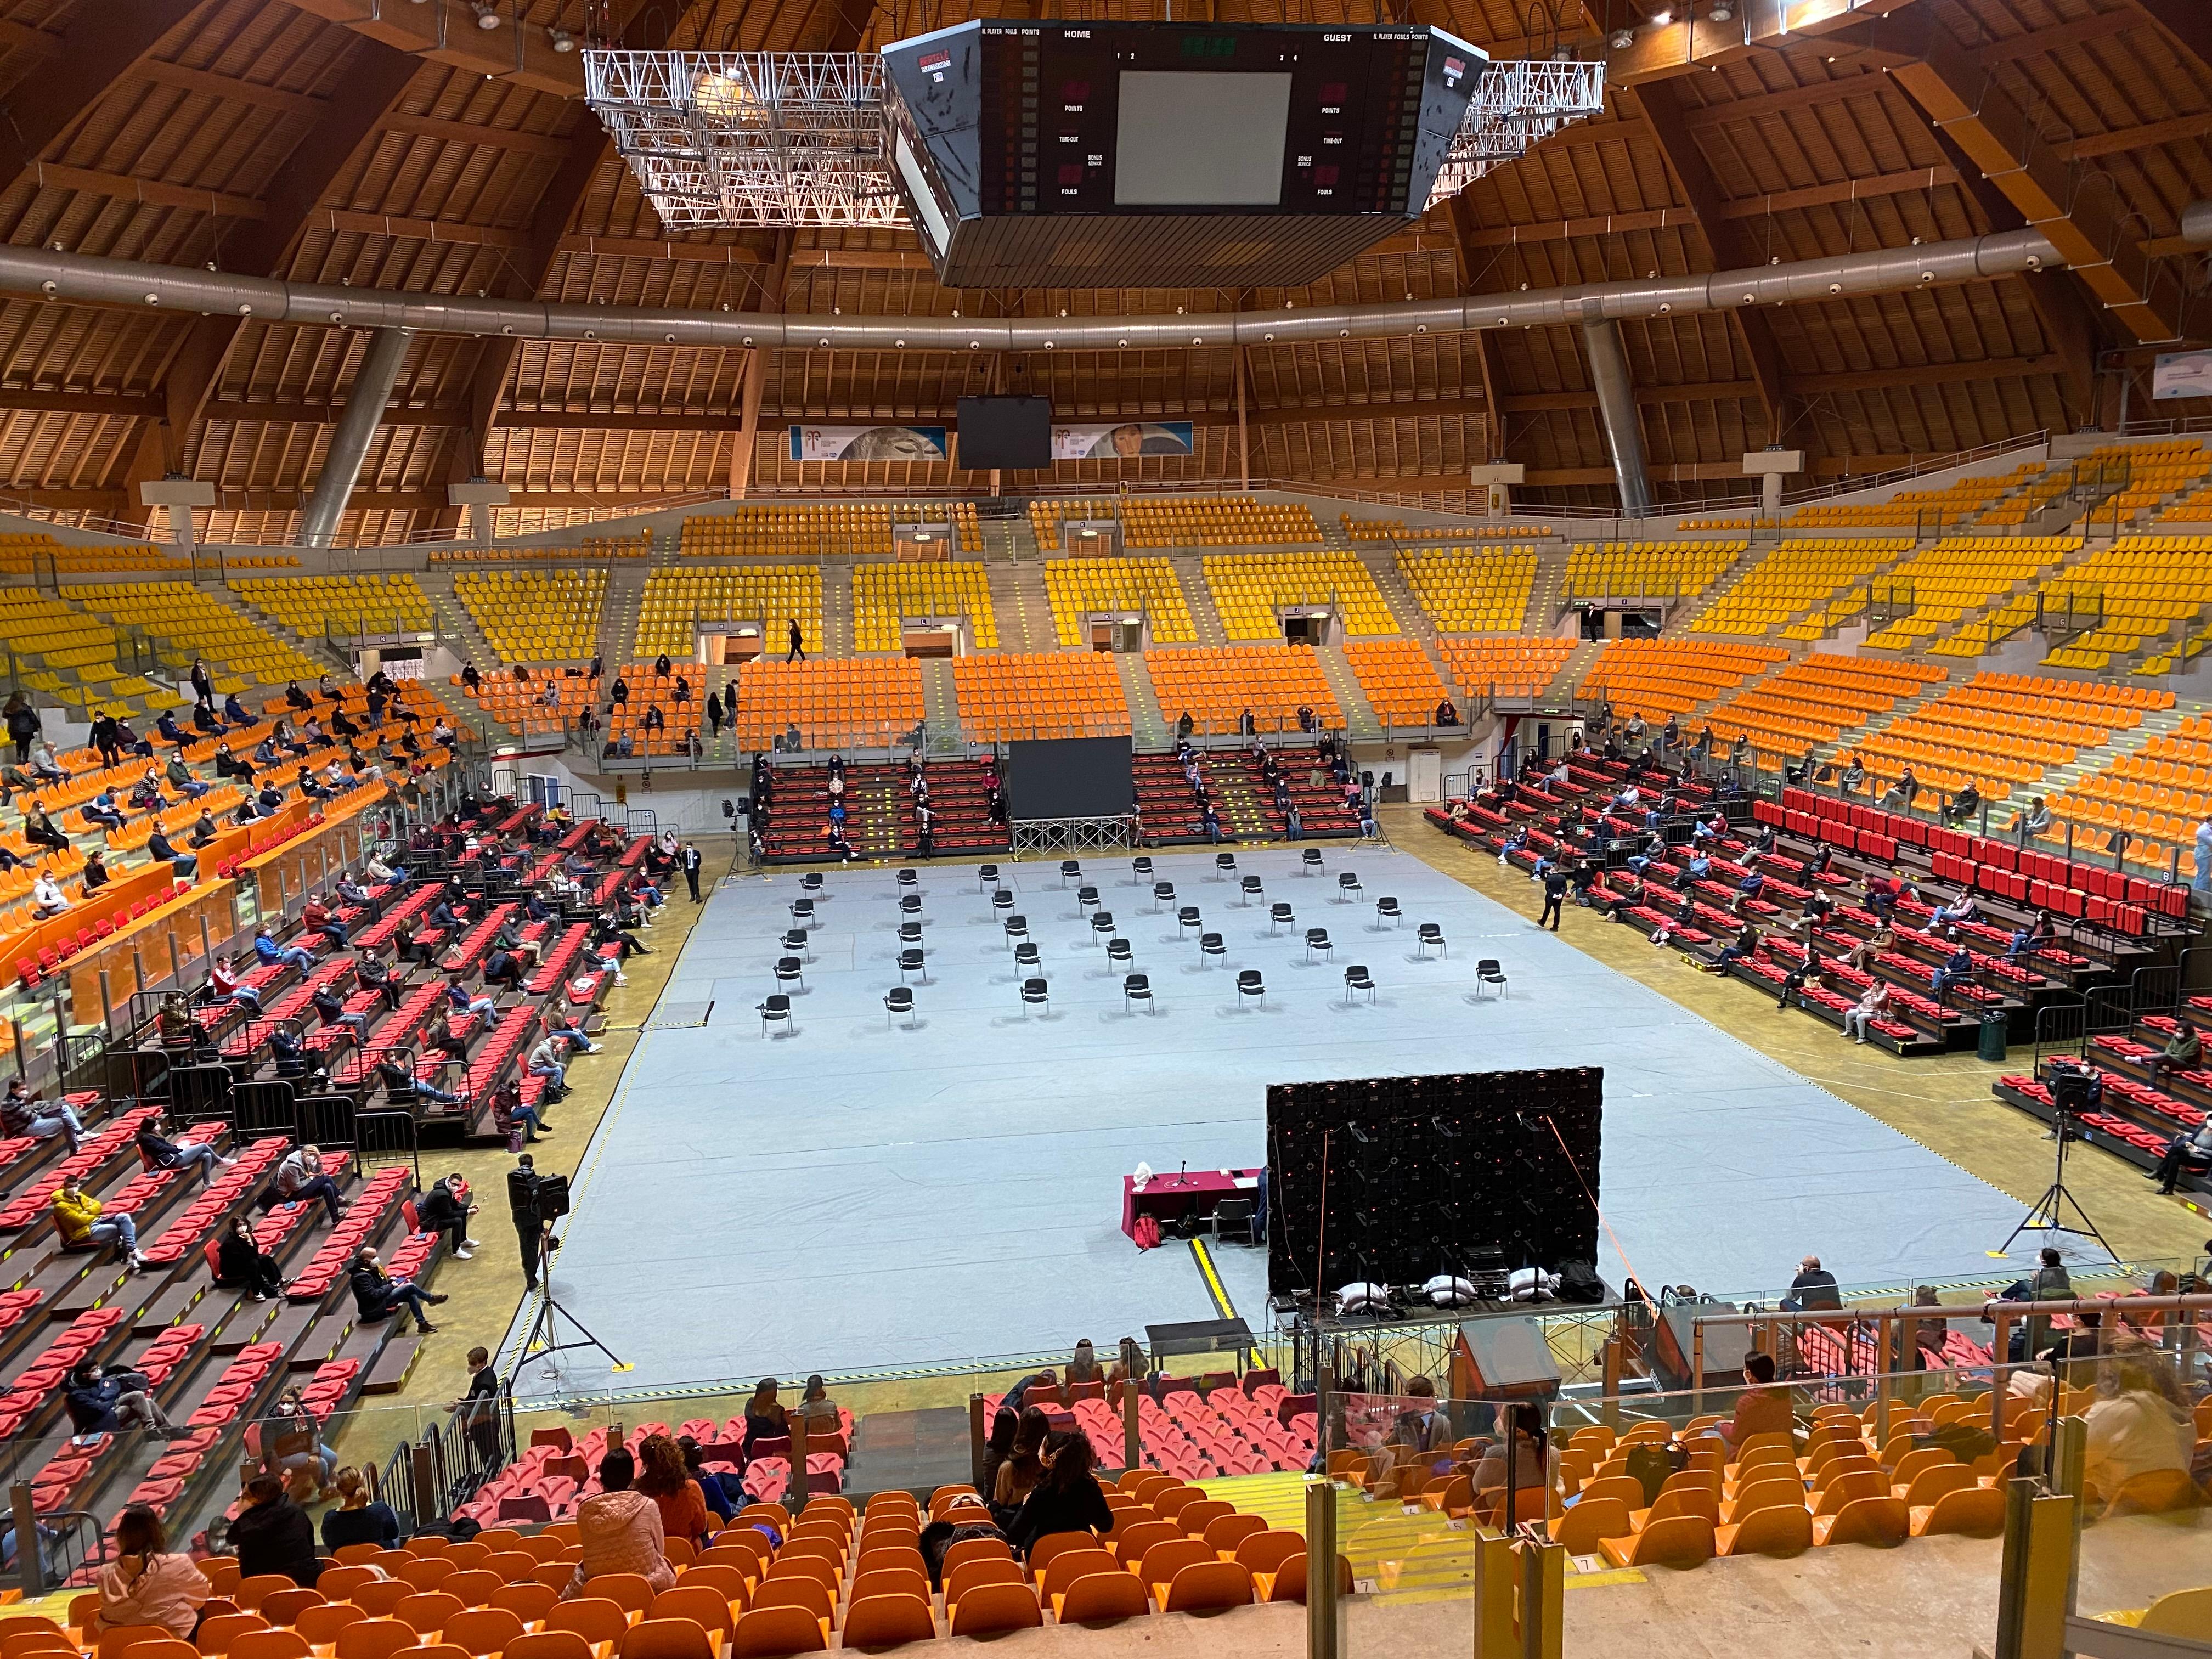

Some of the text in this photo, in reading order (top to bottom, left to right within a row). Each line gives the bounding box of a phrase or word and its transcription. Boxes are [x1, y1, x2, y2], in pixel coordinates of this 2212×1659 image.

[1064, 30, 1091, 38] HOME
[2163, 871, 2169, 881] B
[1580, 1559, 1589, 1570] 7
[1361, 1582, 1368, 1592] 7
